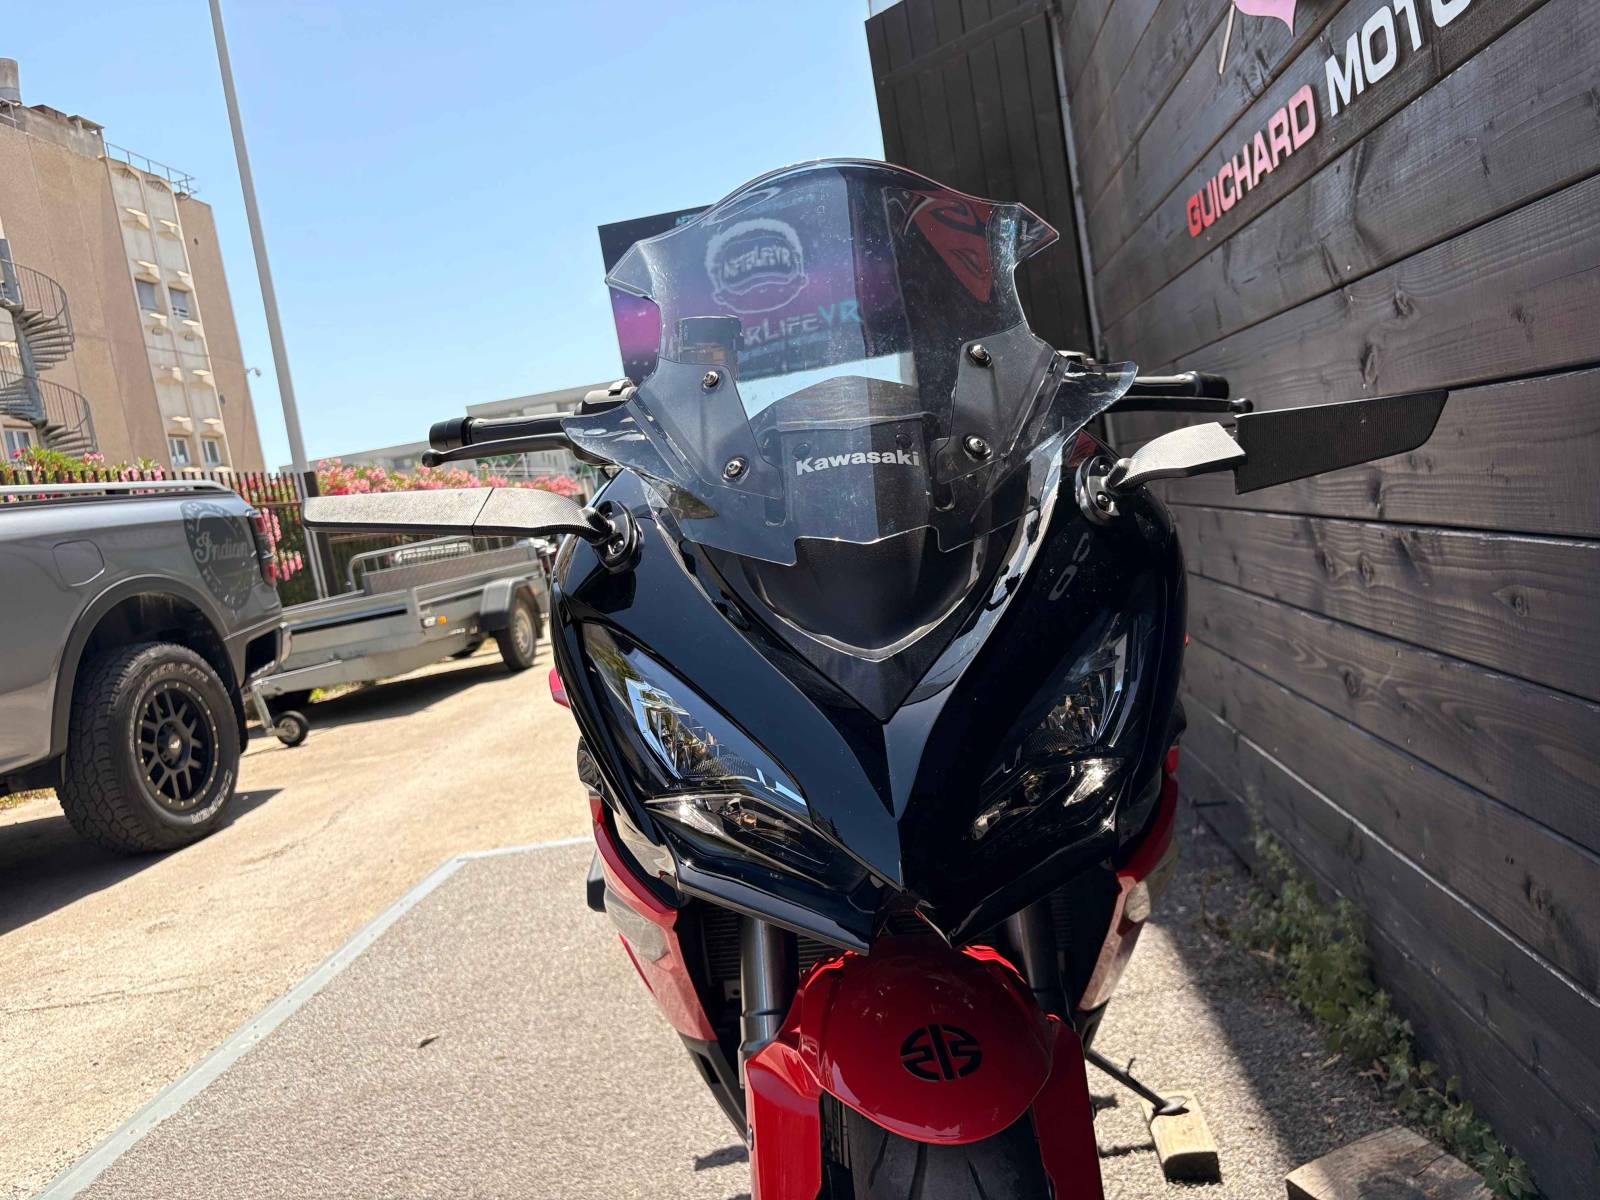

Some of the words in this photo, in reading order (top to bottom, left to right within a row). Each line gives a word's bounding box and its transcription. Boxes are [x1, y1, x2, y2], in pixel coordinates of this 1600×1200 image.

[1186, 84, 1316, 237] GUICHARD
[796, 449, 920, 476] Kawasaki
[193, 531, 249, 564] Indian
